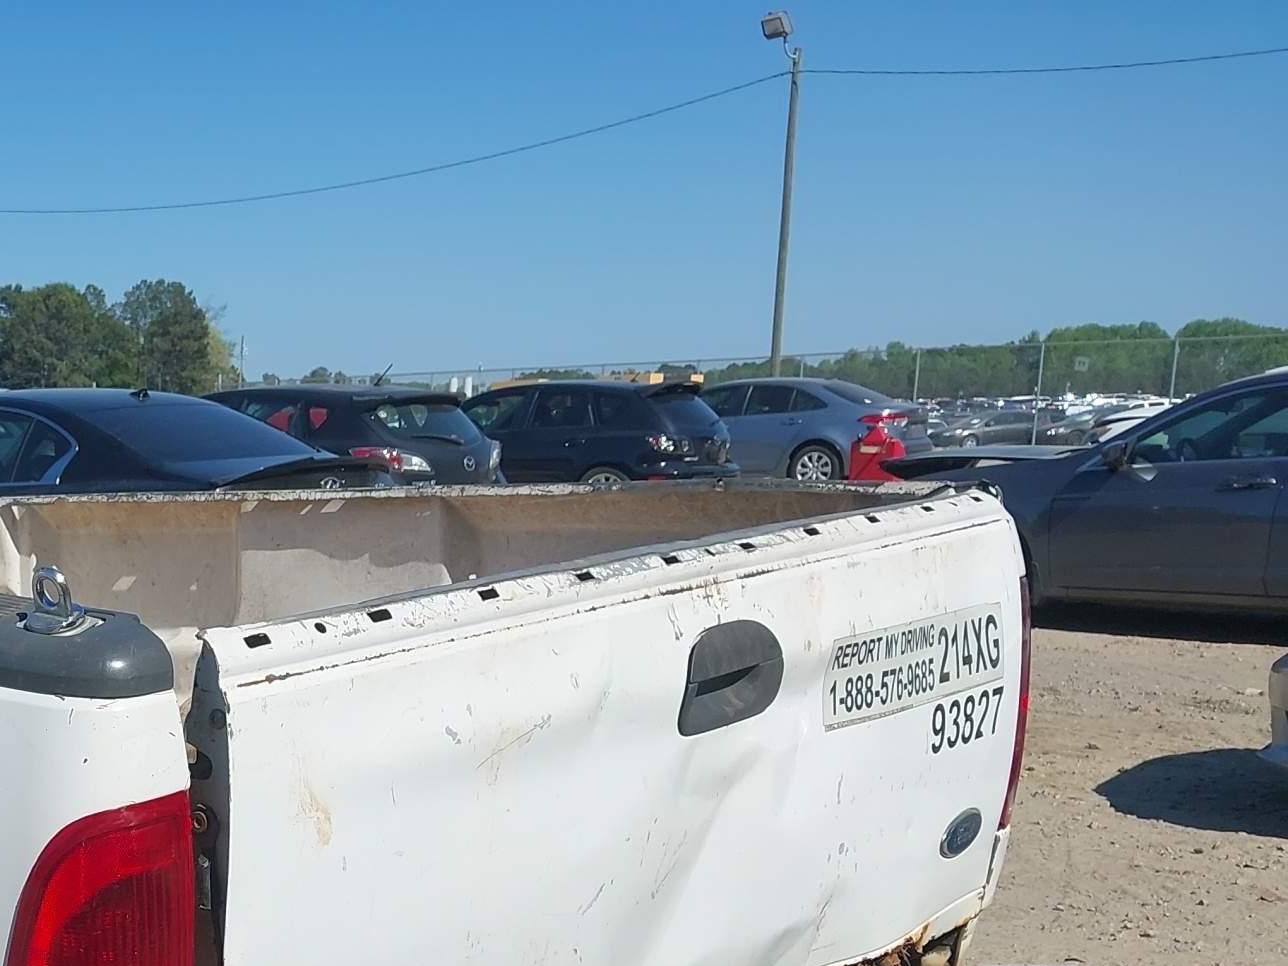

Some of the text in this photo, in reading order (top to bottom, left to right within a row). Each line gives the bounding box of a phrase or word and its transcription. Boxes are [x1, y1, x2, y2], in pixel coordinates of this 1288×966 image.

[832, 624, 935, 671] REPORT MY DRIVING
[937, 614, 1000, 684] 214XG
[829, 657, 935, 715] 1-888-576-9685
[931, 686, 1004, 754] 93827
